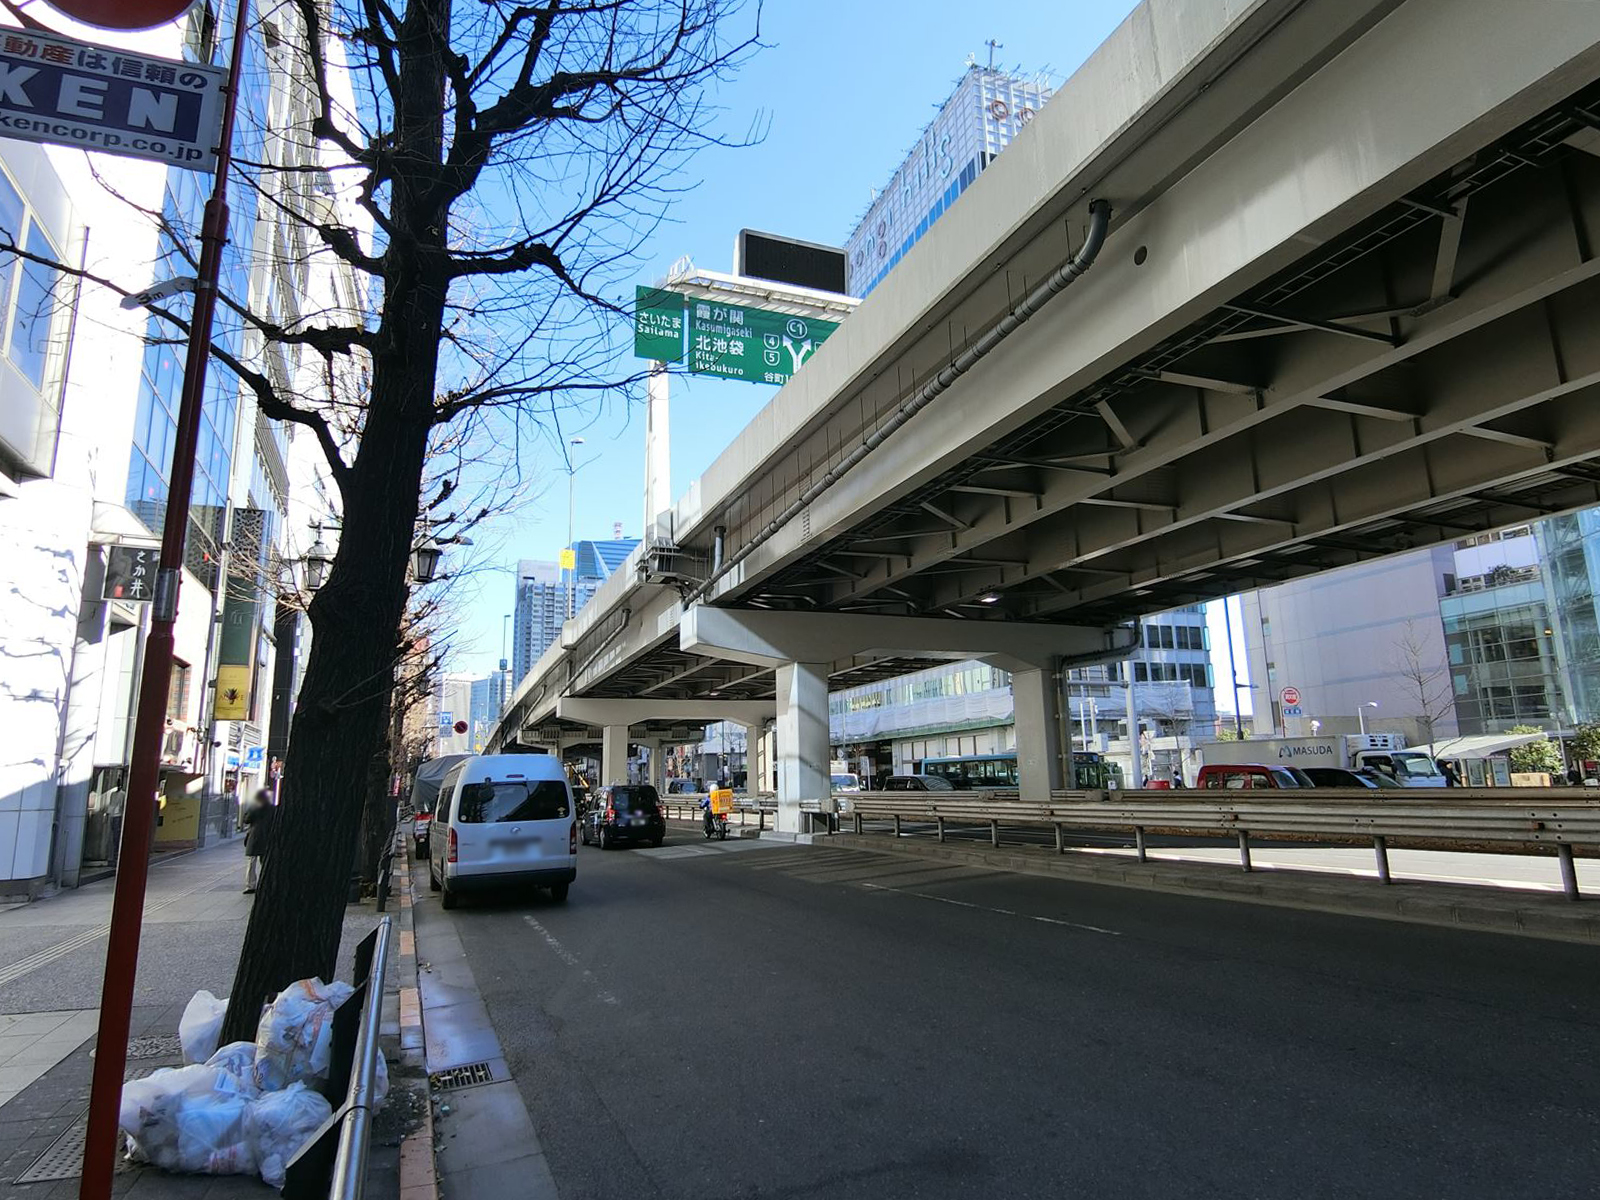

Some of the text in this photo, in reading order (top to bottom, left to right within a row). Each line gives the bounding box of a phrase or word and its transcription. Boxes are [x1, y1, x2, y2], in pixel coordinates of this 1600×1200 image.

[0, 34, 208, 90] 動産は信頼の
[901, 128, 953, 207] hills
[638, 312, 682, 329] さいたま
[696, 304, 744, 325] 霞が関
[637, 324, 680, 339] Saitama
[695, 320, 753, 339] Kasumigaseki
[789, 322, 803, 336] C1
[695, 335, 745, 357] 北池袋
[768, 337, 775, 347] 4
[695, 350, 719, 363] Kita-
[768, 353, 775, 363] 5
[130, 550, 146, 599] さか井
[1293, 745, 1333, 755] MASUDA
